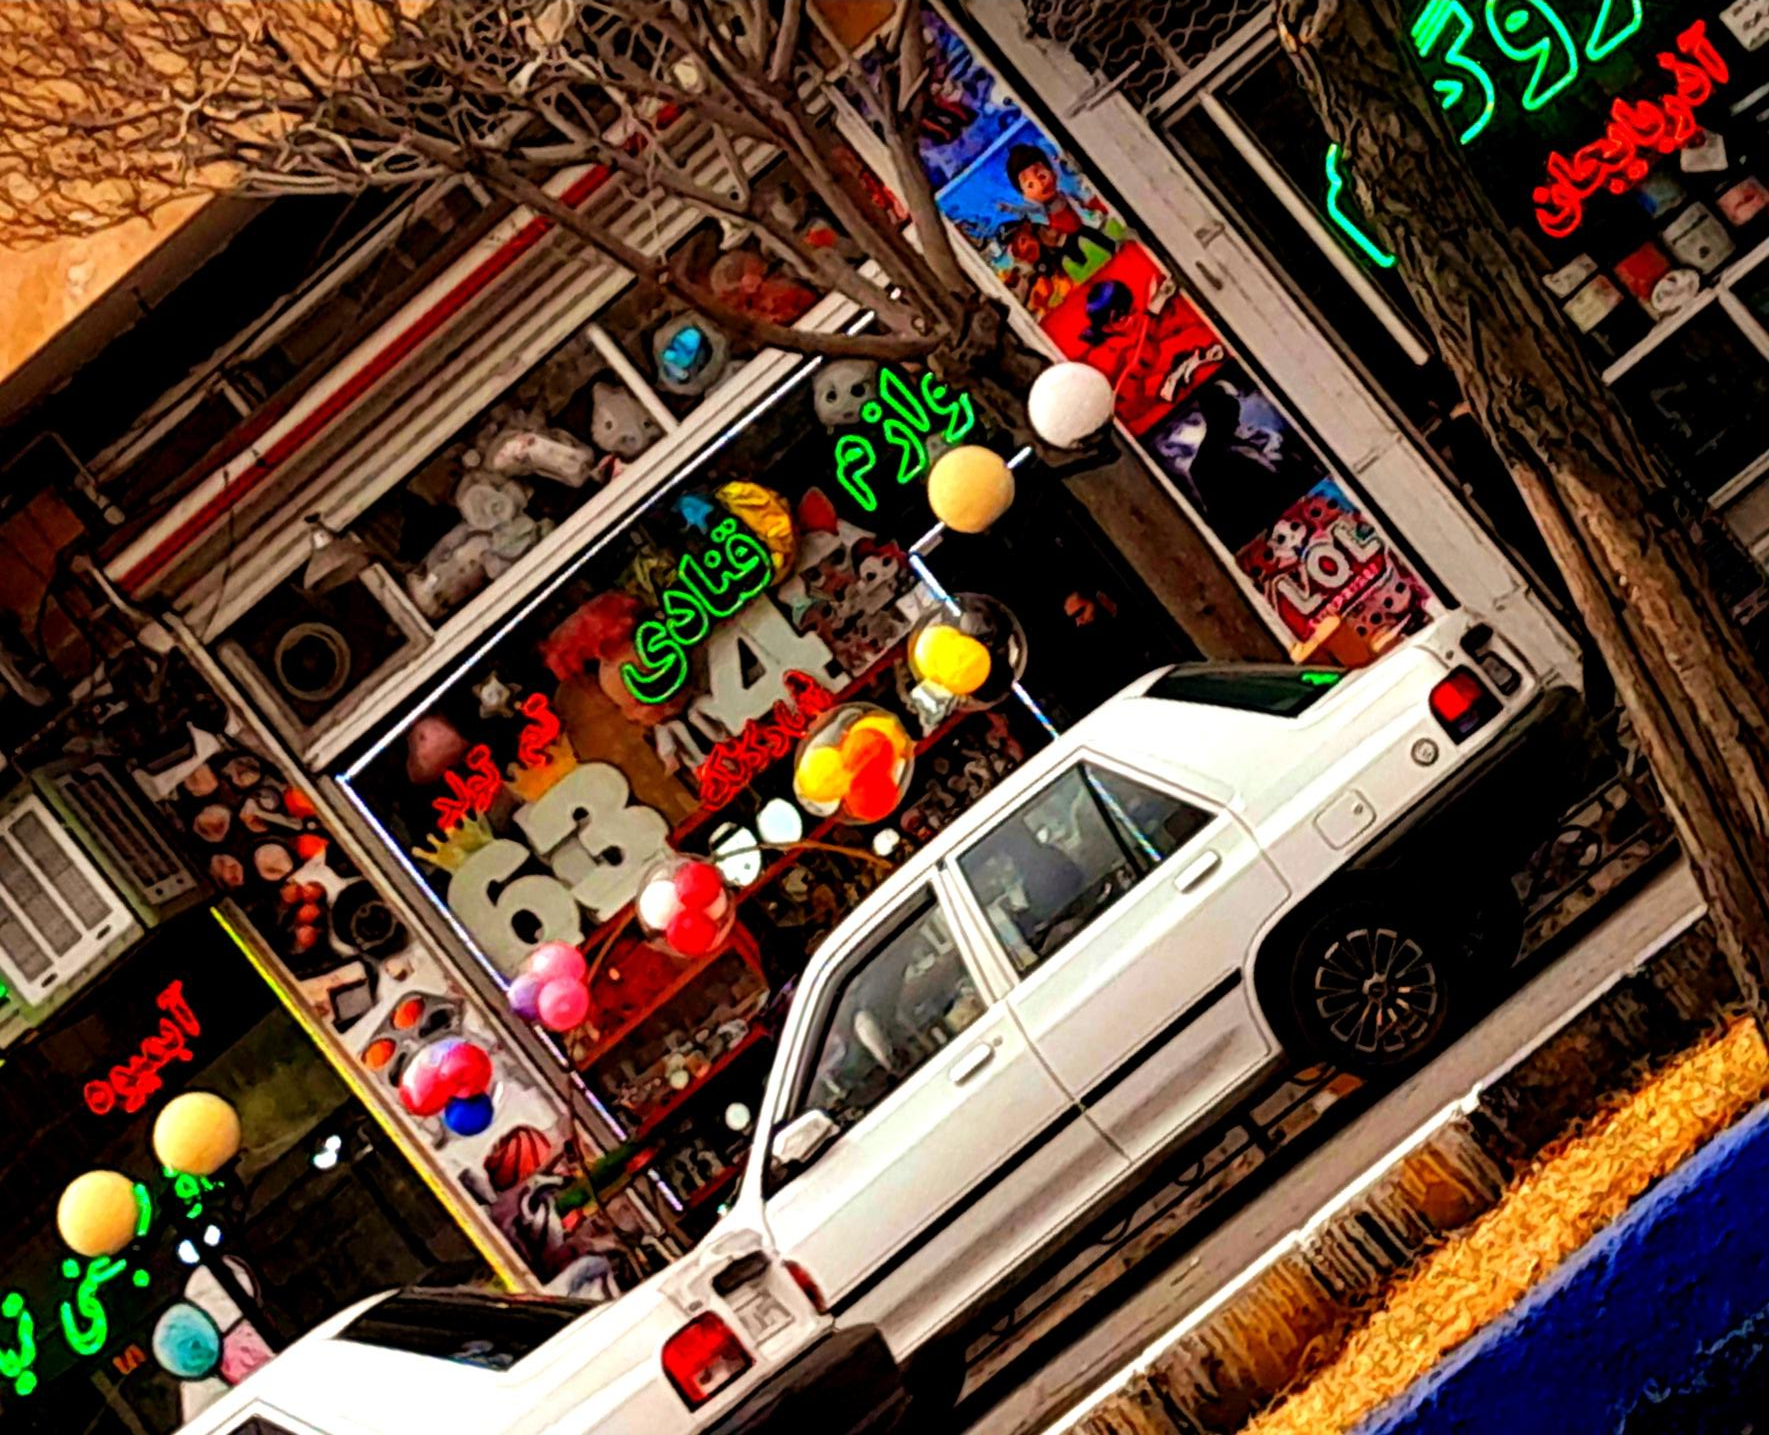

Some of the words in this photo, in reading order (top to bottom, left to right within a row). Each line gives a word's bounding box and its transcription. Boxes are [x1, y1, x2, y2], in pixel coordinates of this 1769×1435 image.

[1533, 19, 1730, 239] آذربایجان
[834, 367, 976, 513] وازم
[622, 517, 773, 704] قنادی
[1279, 524, 1383, 619] LOL
[83, 979, 200, 1116] آبمیوه
